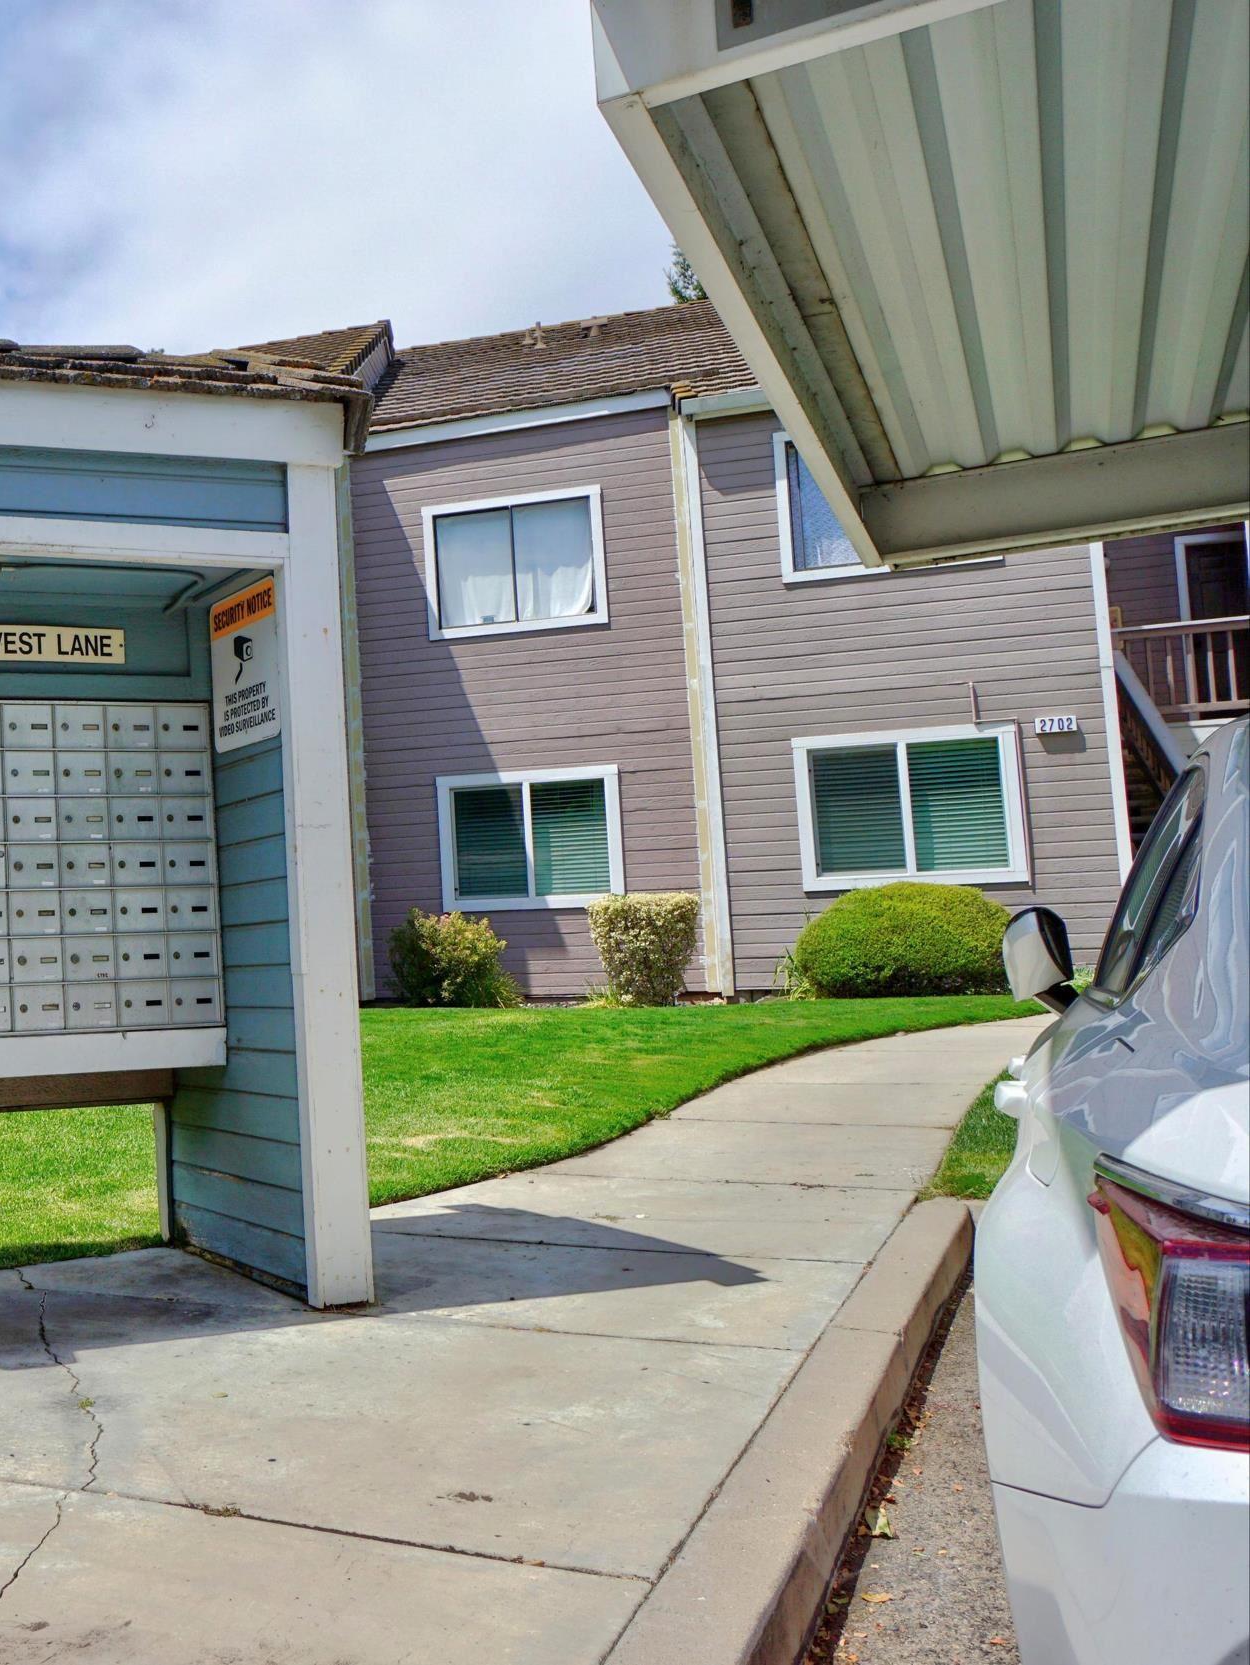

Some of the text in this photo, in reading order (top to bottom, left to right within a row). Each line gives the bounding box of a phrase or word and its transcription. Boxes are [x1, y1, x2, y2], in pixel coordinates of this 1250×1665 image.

[214, 588, 272, 632] SECURITY NOTICE
[56, 634, 112, 656] LANE
[225, 681, 266, 707] THIS PROPERTY
[224, 695, 269, 722] IS PROTECTED BY
[219, 708, 276, 738] VIDEO SURVEILLANCE
[1040, 717, 1073, 732] 2702
